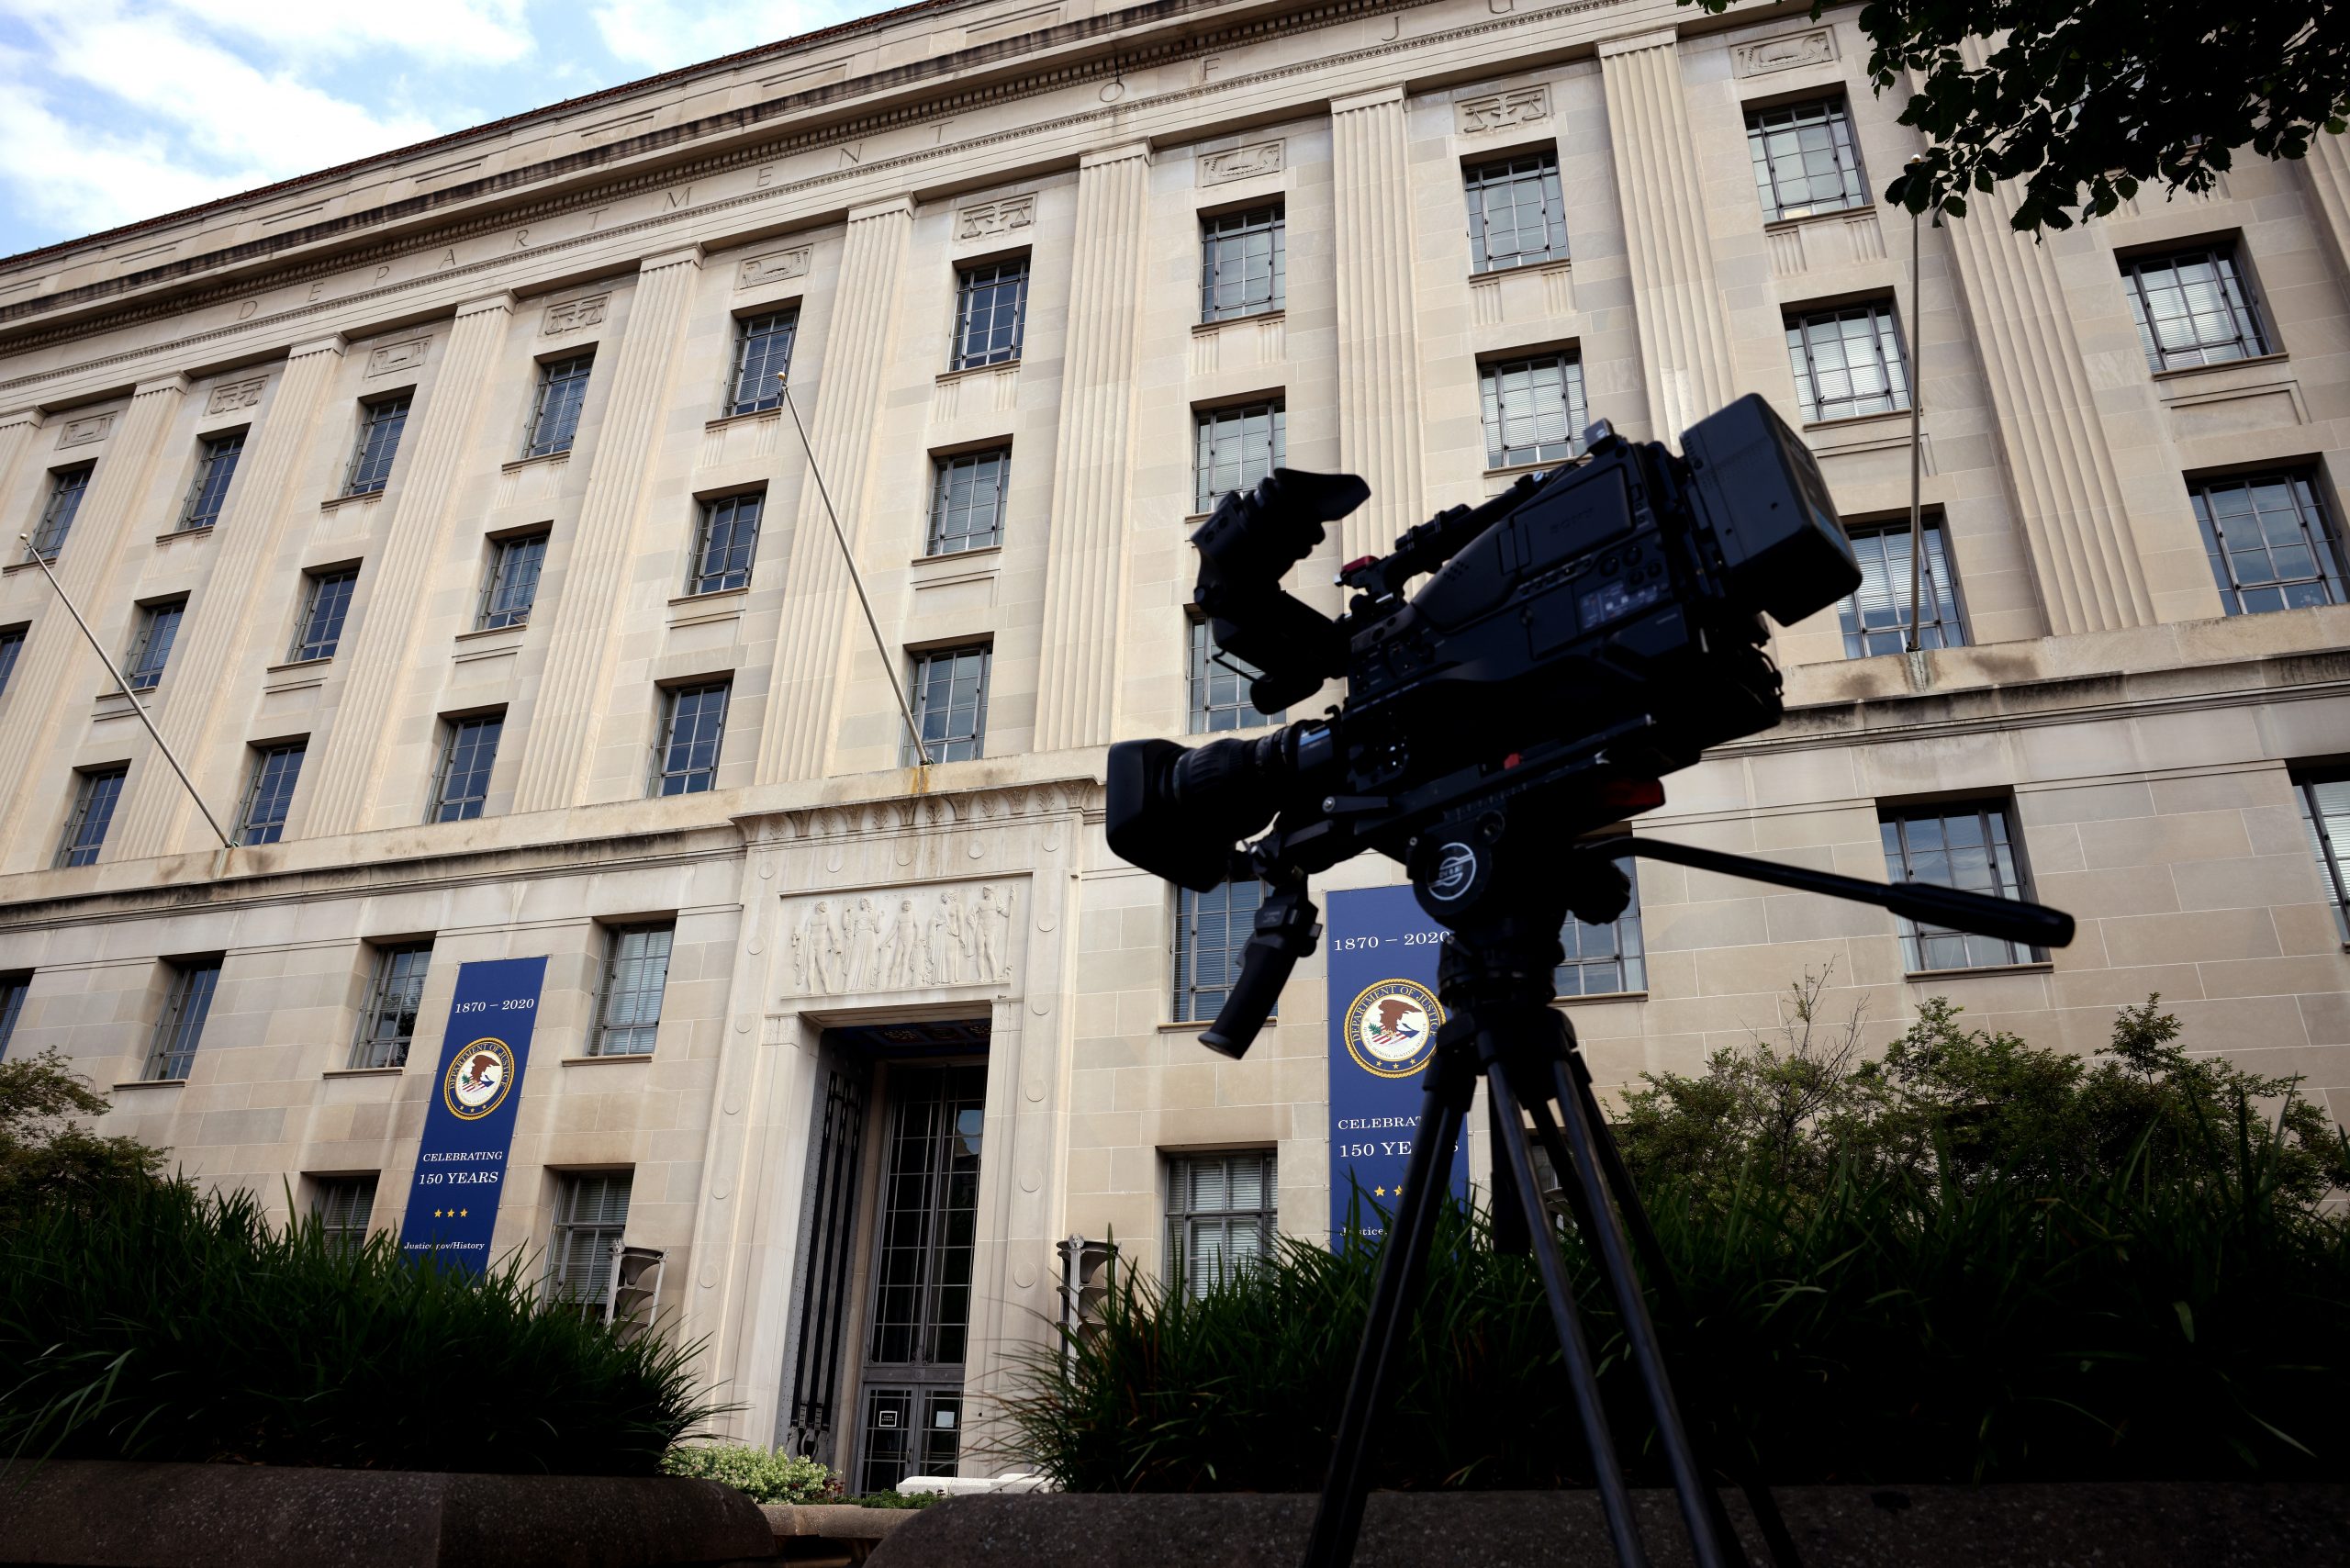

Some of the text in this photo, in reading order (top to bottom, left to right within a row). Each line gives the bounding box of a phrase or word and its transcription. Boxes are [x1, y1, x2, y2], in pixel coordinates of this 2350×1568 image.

[237, 120, 954, 321] DEPARTMENT
[1099, 57, 1220, 103] OF
[1334, 936, 1379, 951] 1870
[1404, 930, 1450, 946] 2020
[454, 1002, 486, 1014] 1870
[501, 998, 534, 1010] 2020
[1351, 986, 1440, 1042] DEPARTMENT OF JUSTICE
[450, 1044, 509, 1090] DEPARTMENT OF JUSTICE
[1337, 1115, 1422, 1130] CELEBRA
[423, 1151, 503, 1162] CELEBRATING
[1339, 1143, 1375, 1158] 150
[419, 1171, 498, 1185] 150 YEARS
